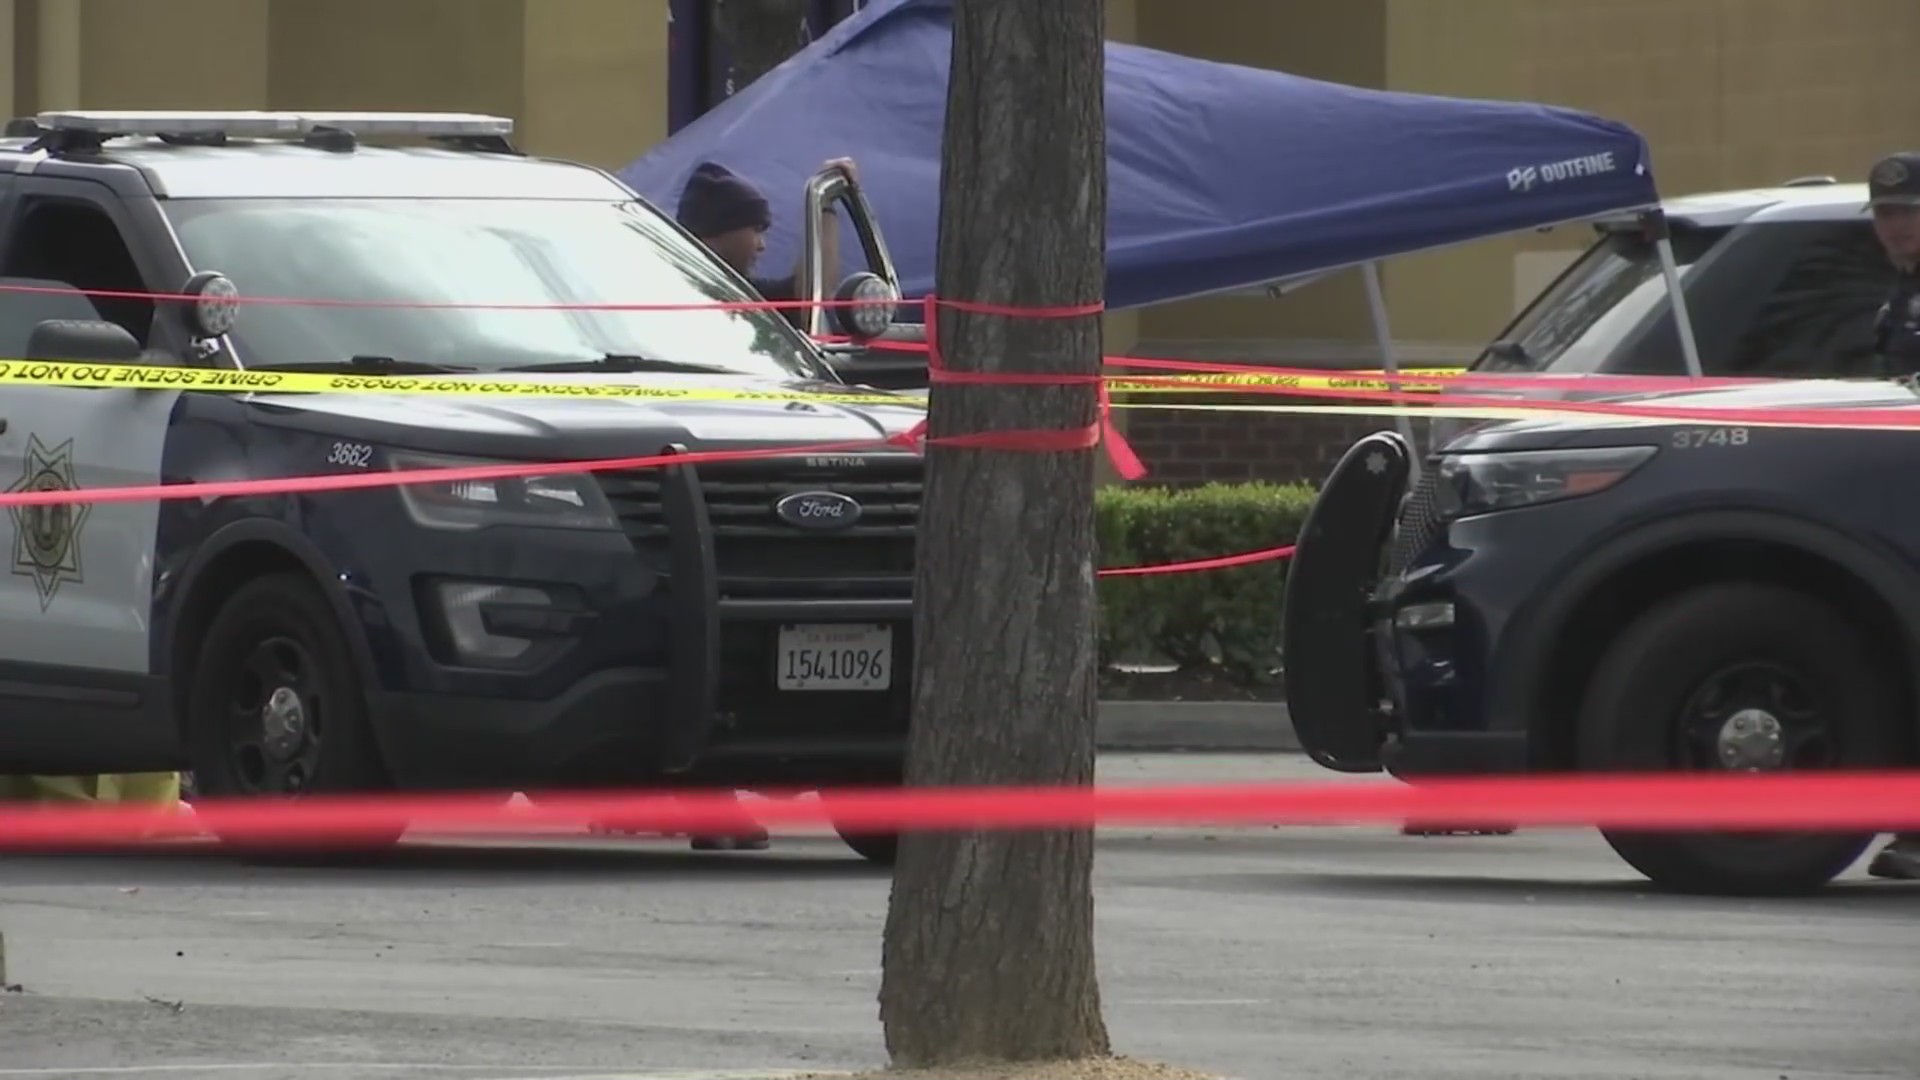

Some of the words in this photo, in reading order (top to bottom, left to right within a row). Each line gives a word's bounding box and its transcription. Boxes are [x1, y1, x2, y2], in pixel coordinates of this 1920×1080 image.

[1541, 152, 1616, 182] OUTFINE
[14, 365, 69, 379] NOT
[73, 367, 111, 380] DO
[114, 369, 199, 383] SCENE
[202, 373, 283, 386] CRIME
[330, 378, 419, 390] CROSS
[1672, 428, 1749, 448] 3748
[328, 442, 372, 467] 3662
[800, 501, 844, 517] Ford
[786, 649, 883, 680] 1541096
